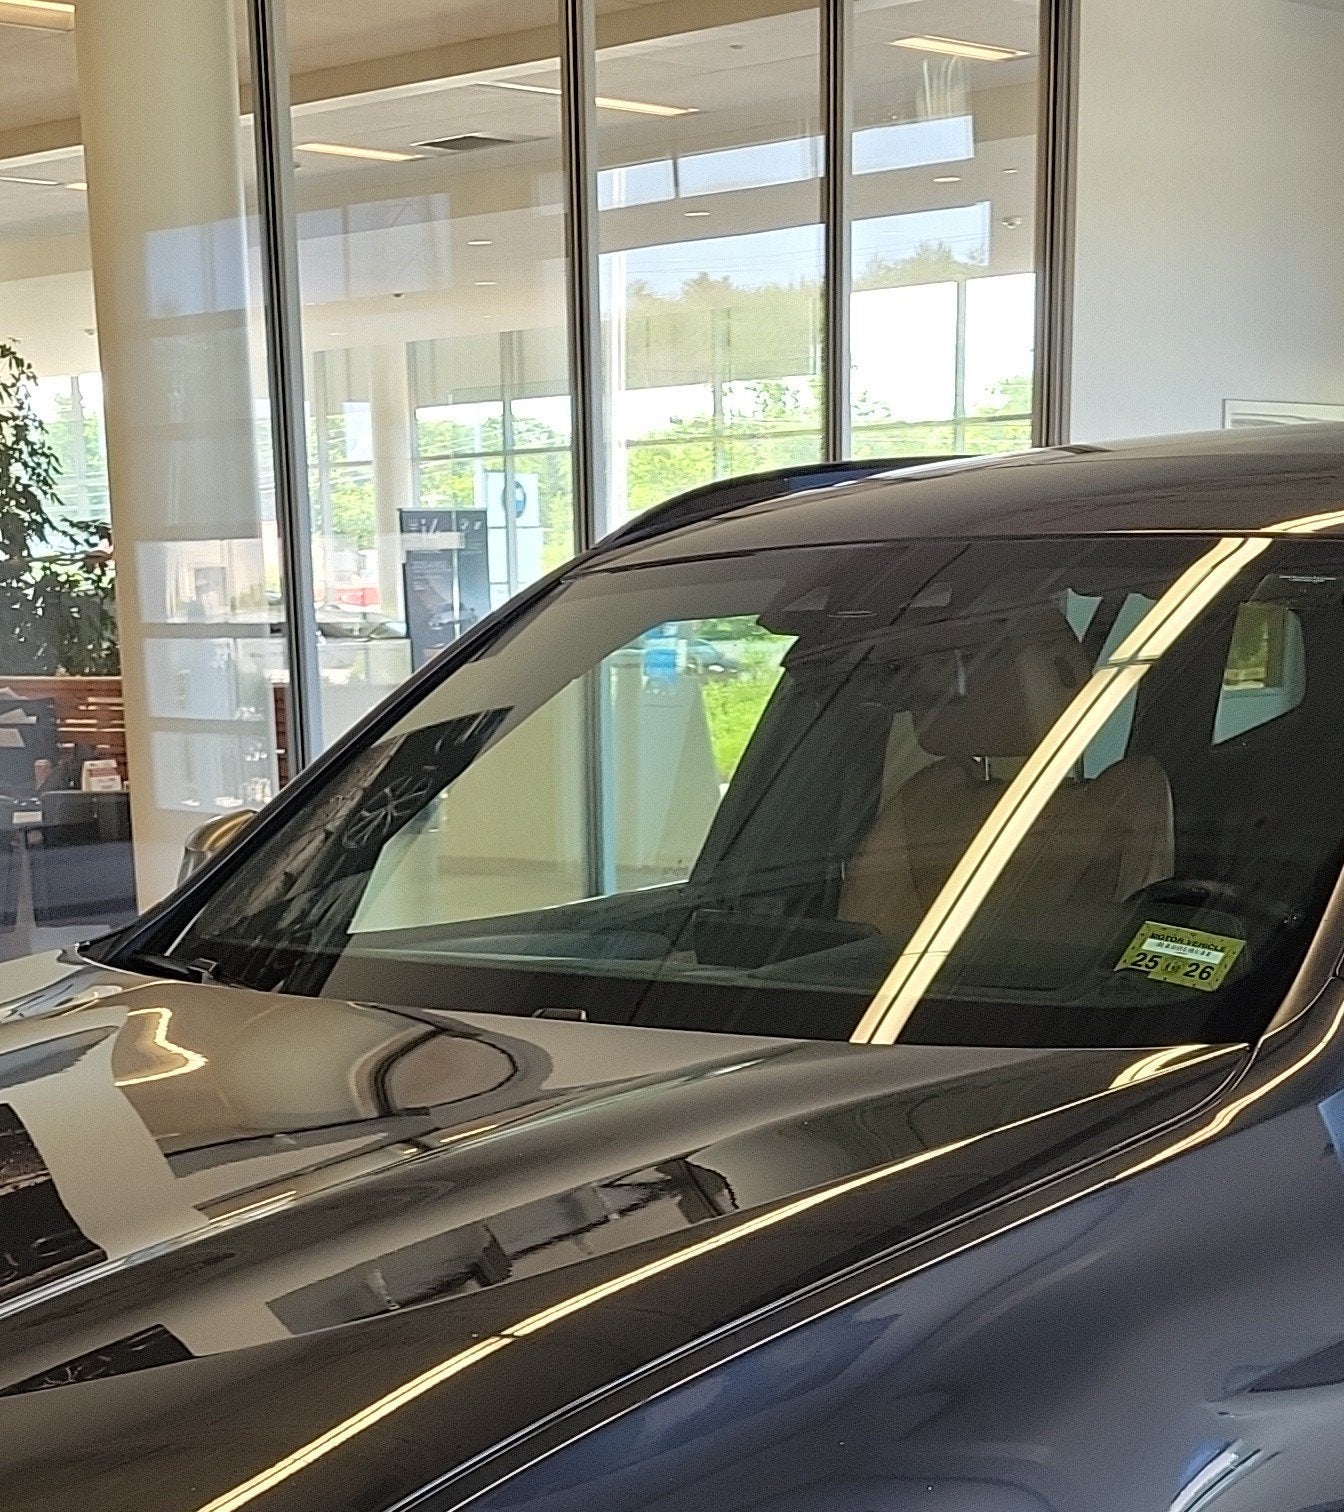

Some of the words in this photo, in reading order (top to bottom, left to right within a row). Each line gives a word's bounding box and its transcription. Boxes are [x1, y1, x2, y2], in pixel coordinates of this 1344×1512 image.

[1150, 932, 1185, 944] MOTOR
[1186, 938, 1227, 953] VEHICLE
[1130, 951, 1163, 970] 25
[1183, 962, 1215, 981] 26
